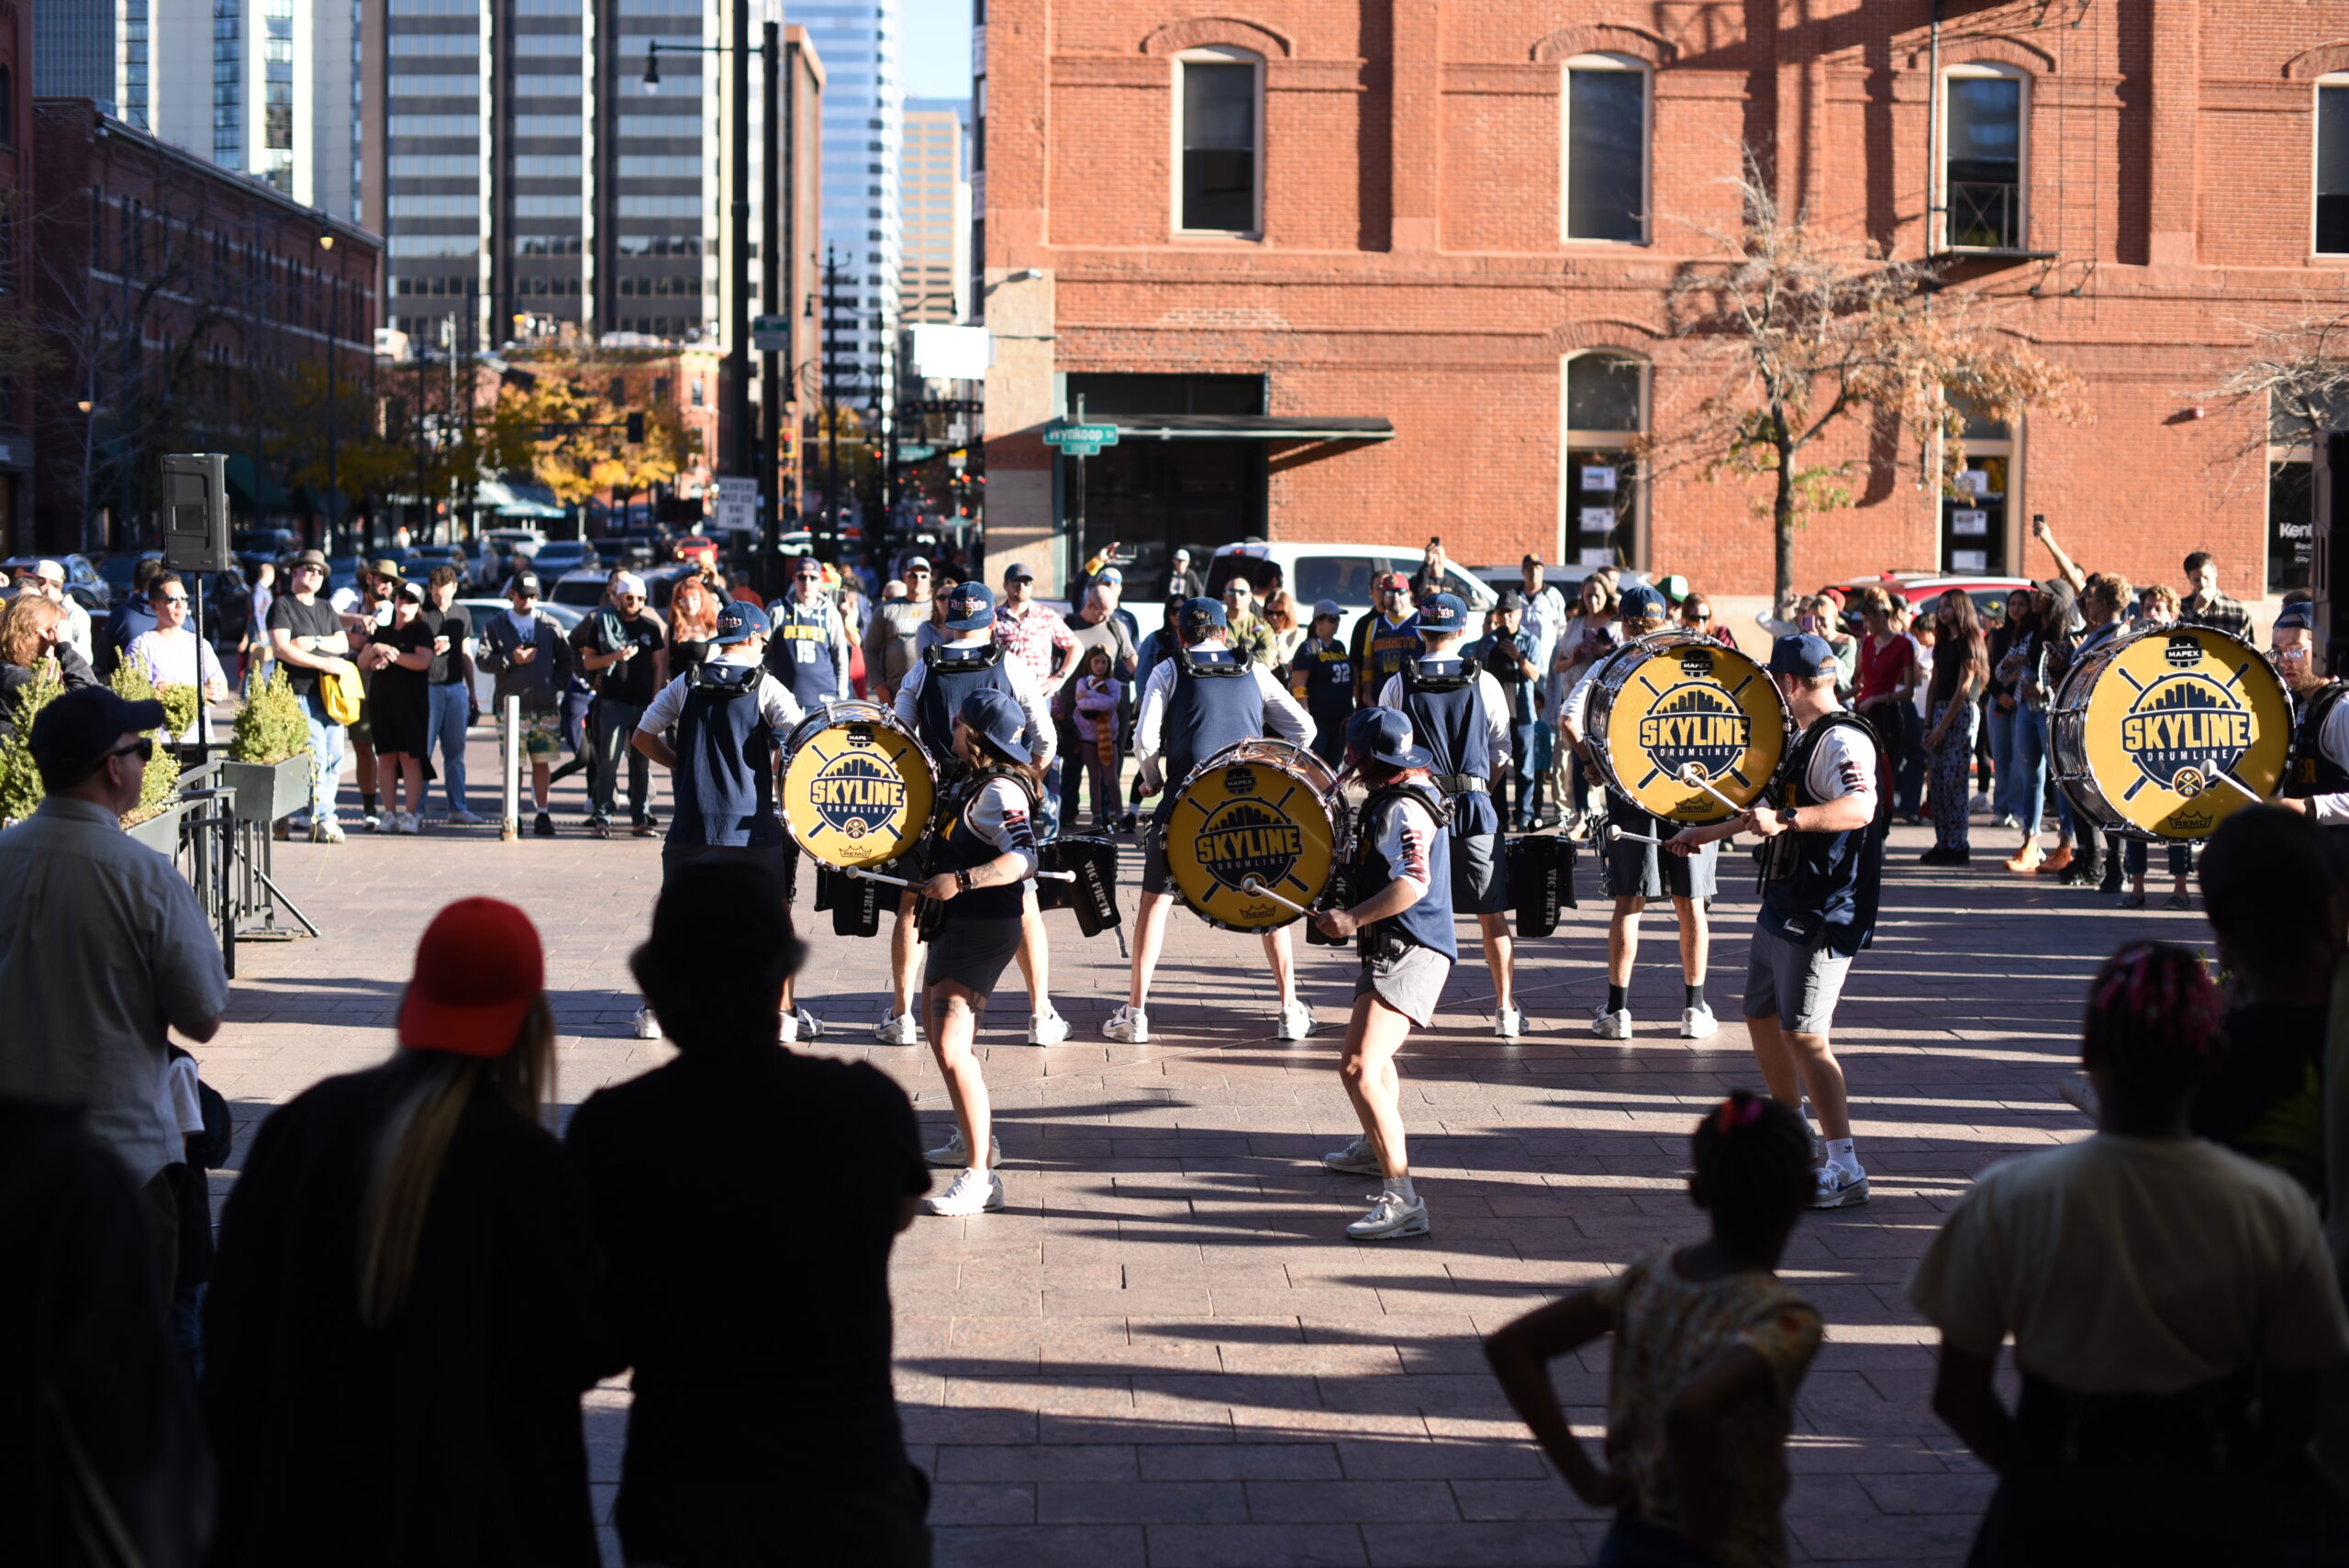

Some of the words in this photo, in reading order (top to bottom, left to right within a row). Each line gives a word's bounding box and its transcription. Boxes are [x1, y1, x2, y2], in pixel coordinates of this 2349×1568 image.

[1049, 428, 1103, 442] Wynkoop
[784, 625, 827, 643] DENVER
[796, 639, 816, 663] 15
[1332, 662, 1351, 684] 32
[1642, 716, 1748, 747] SKYLINE
[2125, 713, 2249, 750] SKYLINE
[1660, 747, 1730, 757] DRUMLINE
[2147, 749, 2228, 762] DRUMLINE
[812, 779, 903, 806] SKYLINE
[827, 805, 886, 815] DRUMLINE
[2174, 819, 2209, 828] REMO
[1197, 827, 1300, 862] SKYLINE
[1085, 859, 1099, 881] VIC
[1218, 857, 1285, 871] DRUMLINE
[1547, 868, 1557, 888] VIC
[863, 887, 874, 924] FIRTH
[1091, 882, 1111, 917] FIRTH
[1545, 890, 1556, 926] FIRTH
